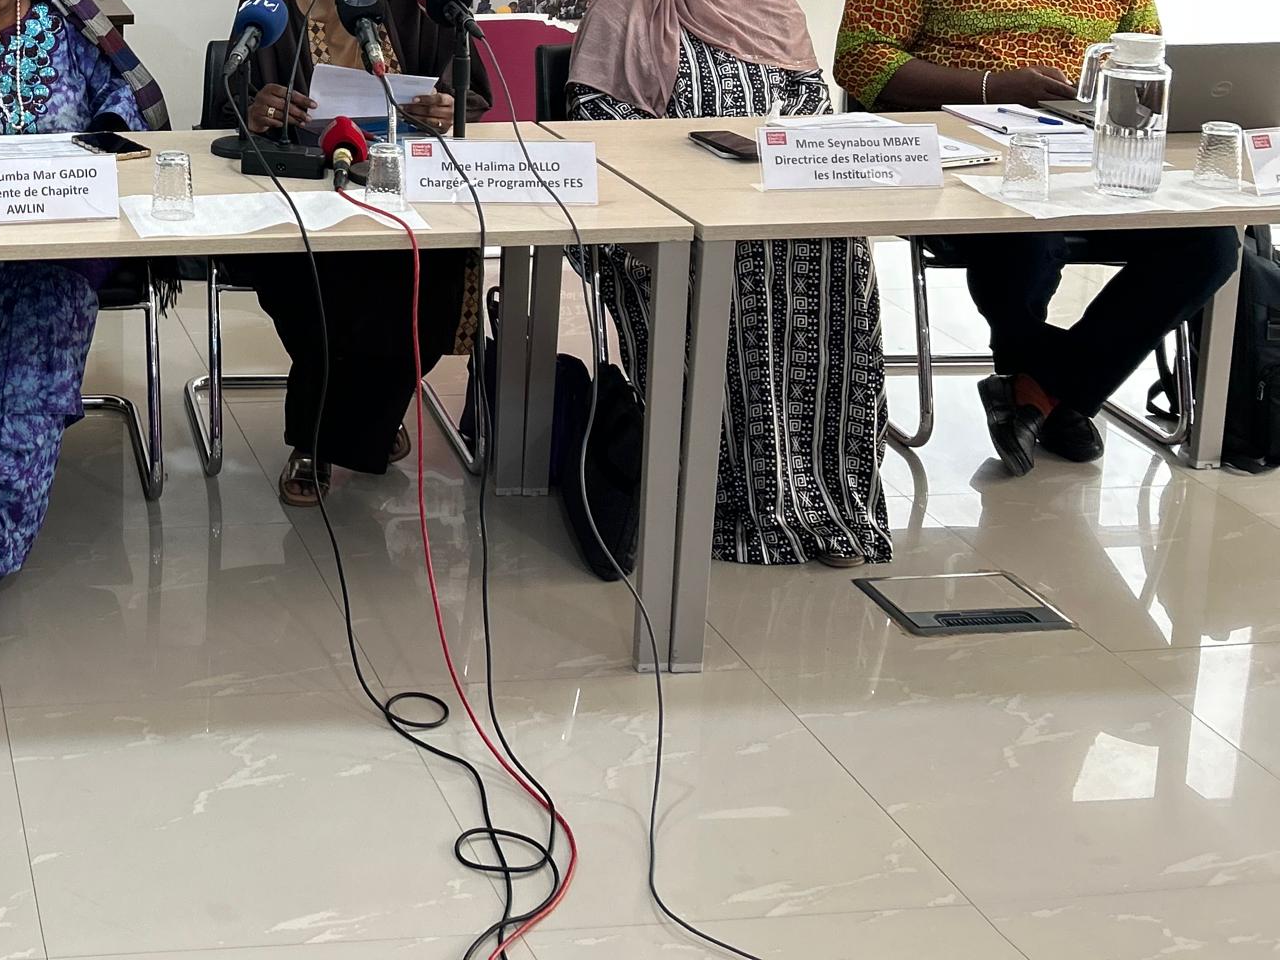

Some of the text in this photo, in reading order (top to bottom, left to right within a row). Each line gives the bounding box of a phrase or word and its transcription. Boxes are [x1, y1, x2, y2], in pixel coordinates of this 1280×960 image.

[796, 138, 825, 148] Mme
[827, 138, 880, 152] Seynabou
[883, 136, 920, 147] MBAYE
[775, 153, 928, 165] Directrice des Relations avec
[475, 162, 515, 172] Halima
[33, 171, 56, 181] Mar
[59, 168, 97, 179] GADIO
[814, 171, 893, 180] les Institutions
[564, 177, 583, 188] FES
[24, 187, 39, 197] de
[41, 186, 89, 199] Chapitre
[7, 203, 45, 215] AWLIN
